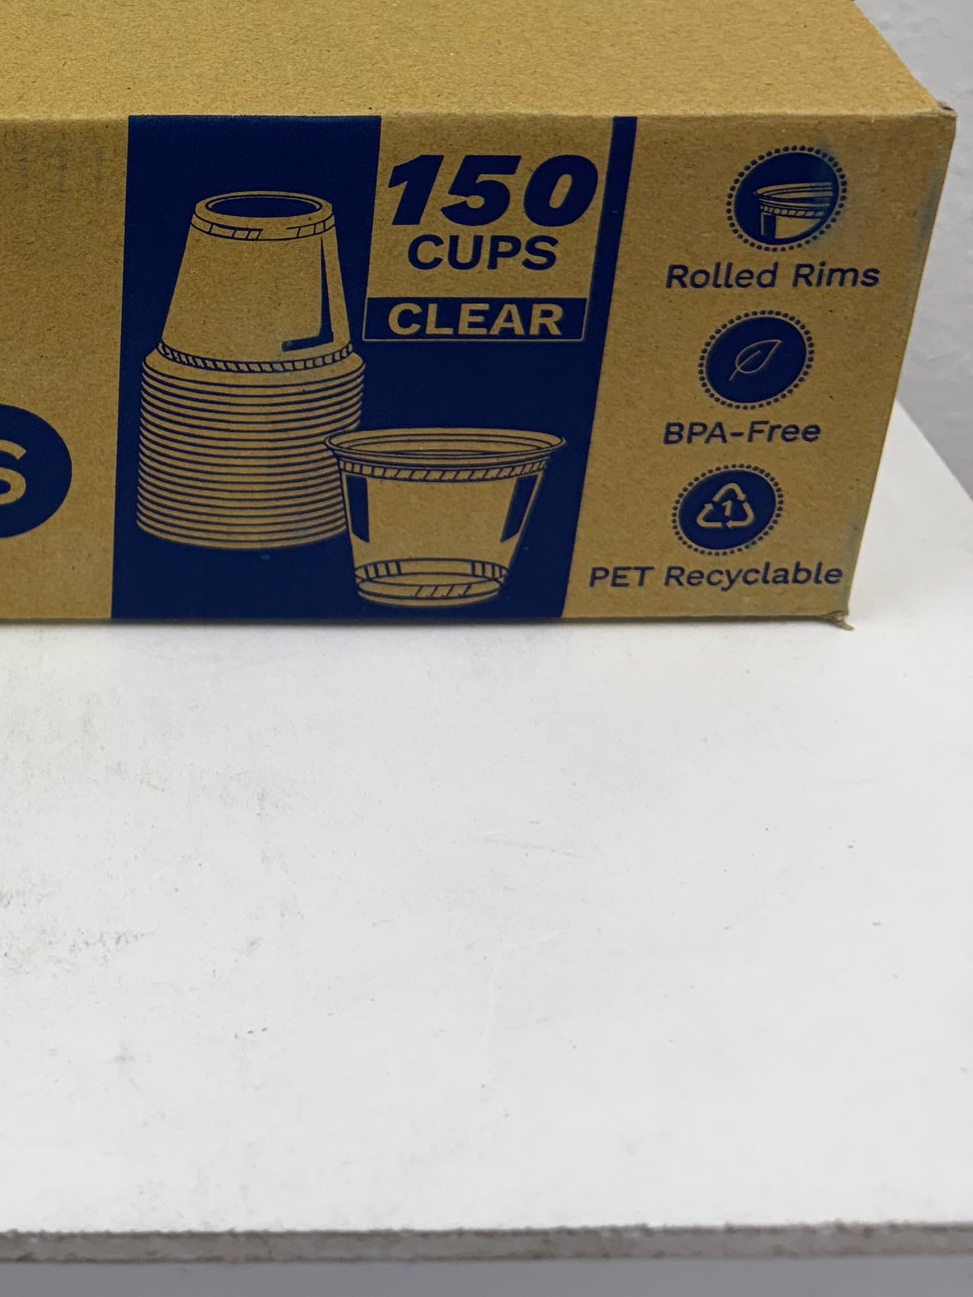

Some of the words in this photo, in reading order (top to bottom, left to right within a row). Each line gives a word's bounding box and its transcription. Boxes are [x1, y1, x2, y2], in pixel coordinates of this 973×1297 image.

[386, 153, 600, 228] 150
[406, 233, 559, 271] CUPS
[664, 260, 778, 290] Rolled
[790, 260, 881, 290] Rims
[386, 301, 564, 337] CLEAR
[662, 418, 822, 446] BPA-Free
[587, 564, 654, 589] PET
[663, 560, 844, 593] Recyclable
